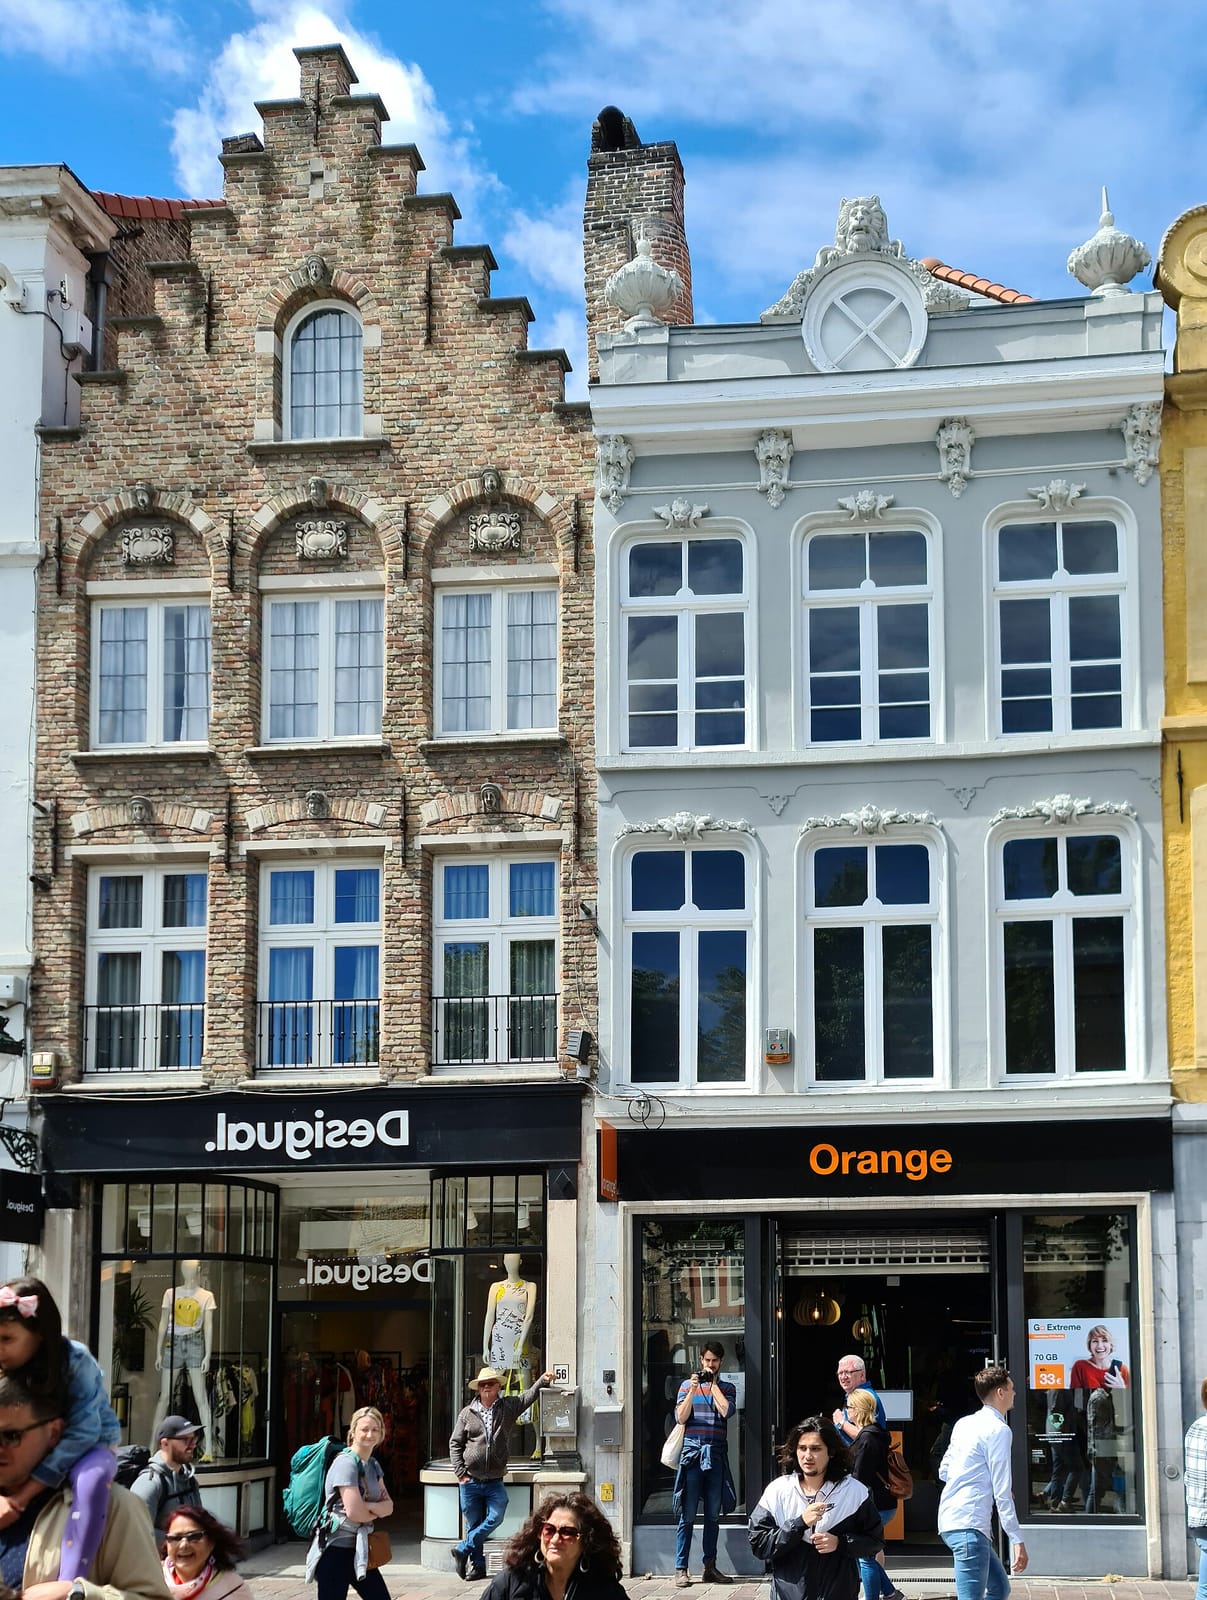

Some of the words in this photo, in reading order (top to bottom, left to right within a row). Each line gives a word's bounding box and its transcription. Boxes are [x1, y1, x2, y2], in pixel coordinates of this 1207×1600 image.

[809, 1143, 953, 1181] Orange
[1047, 1323, 1081, 1331] Extreme
[1034, 1353, 1044, 1361] 70
[1046, 1353, 1058, 1361] GB
[556, 1369, 567, 1380] 56
